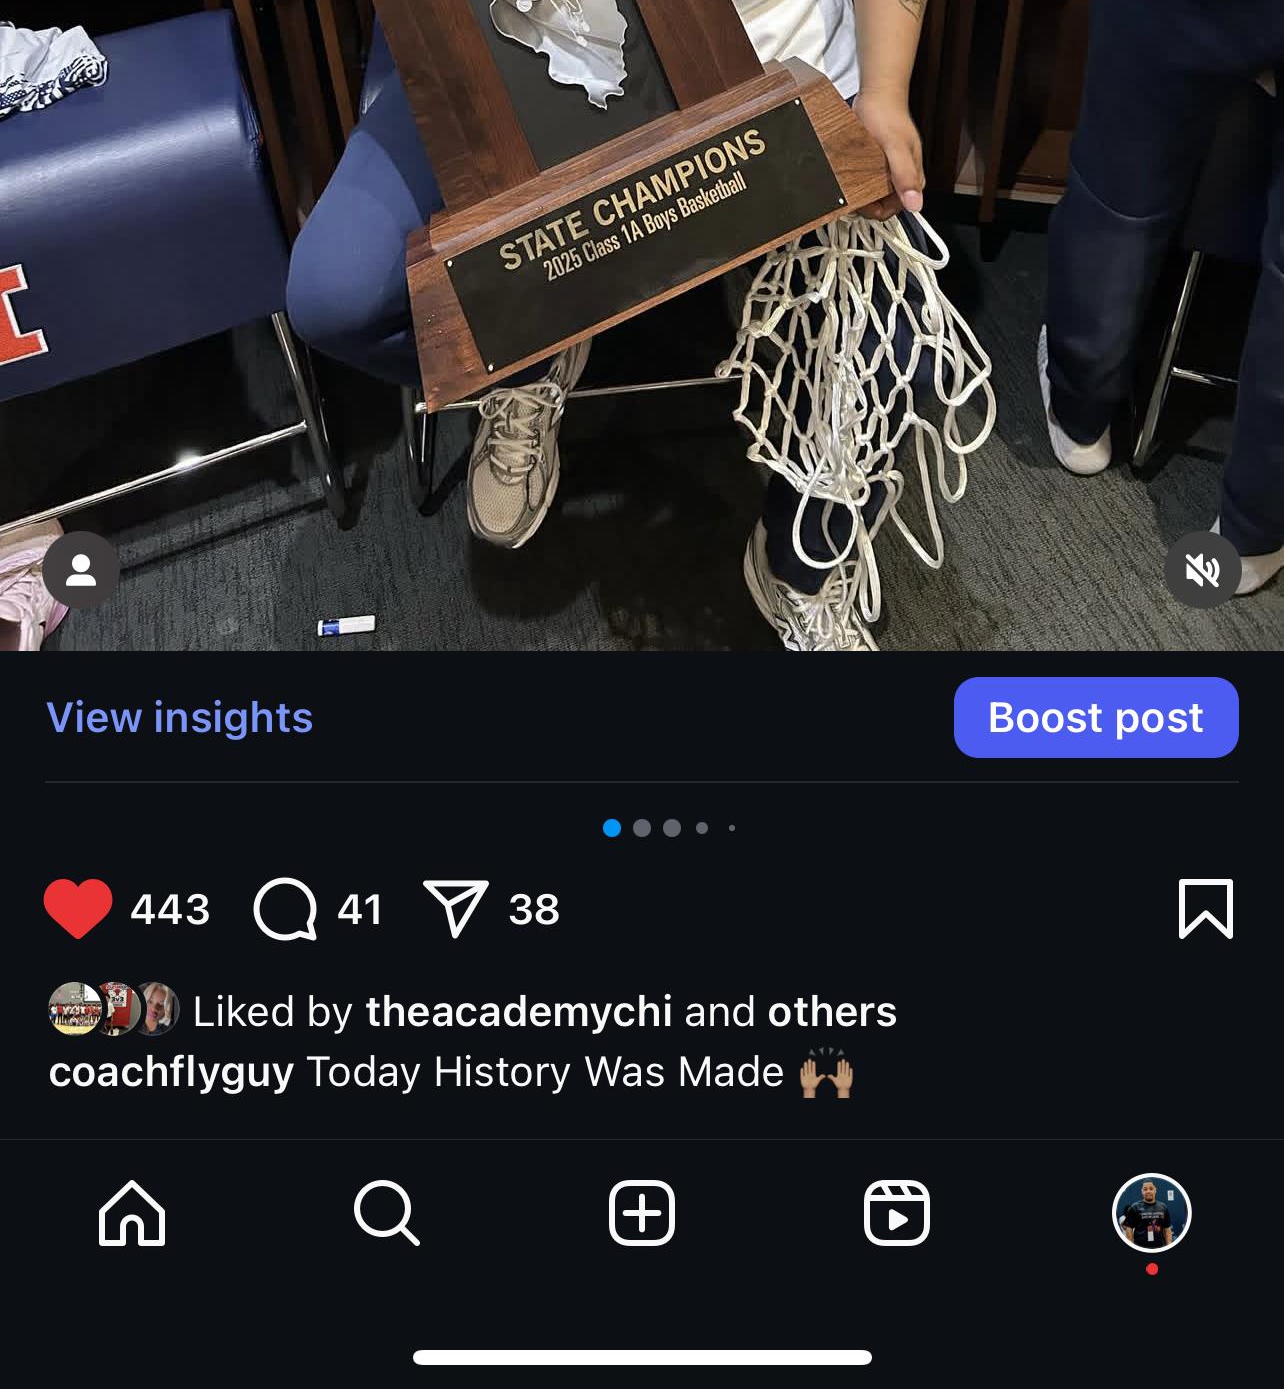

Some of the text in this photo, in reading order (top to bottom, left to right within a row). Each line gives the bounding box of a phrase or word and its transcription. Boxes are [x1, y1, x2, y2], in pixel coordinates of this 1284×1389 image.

[499, 129, 766, 271] STATE CHAMPIONS
[543, 171, 747, 282] 2025 Class 1A Boys Basketball
